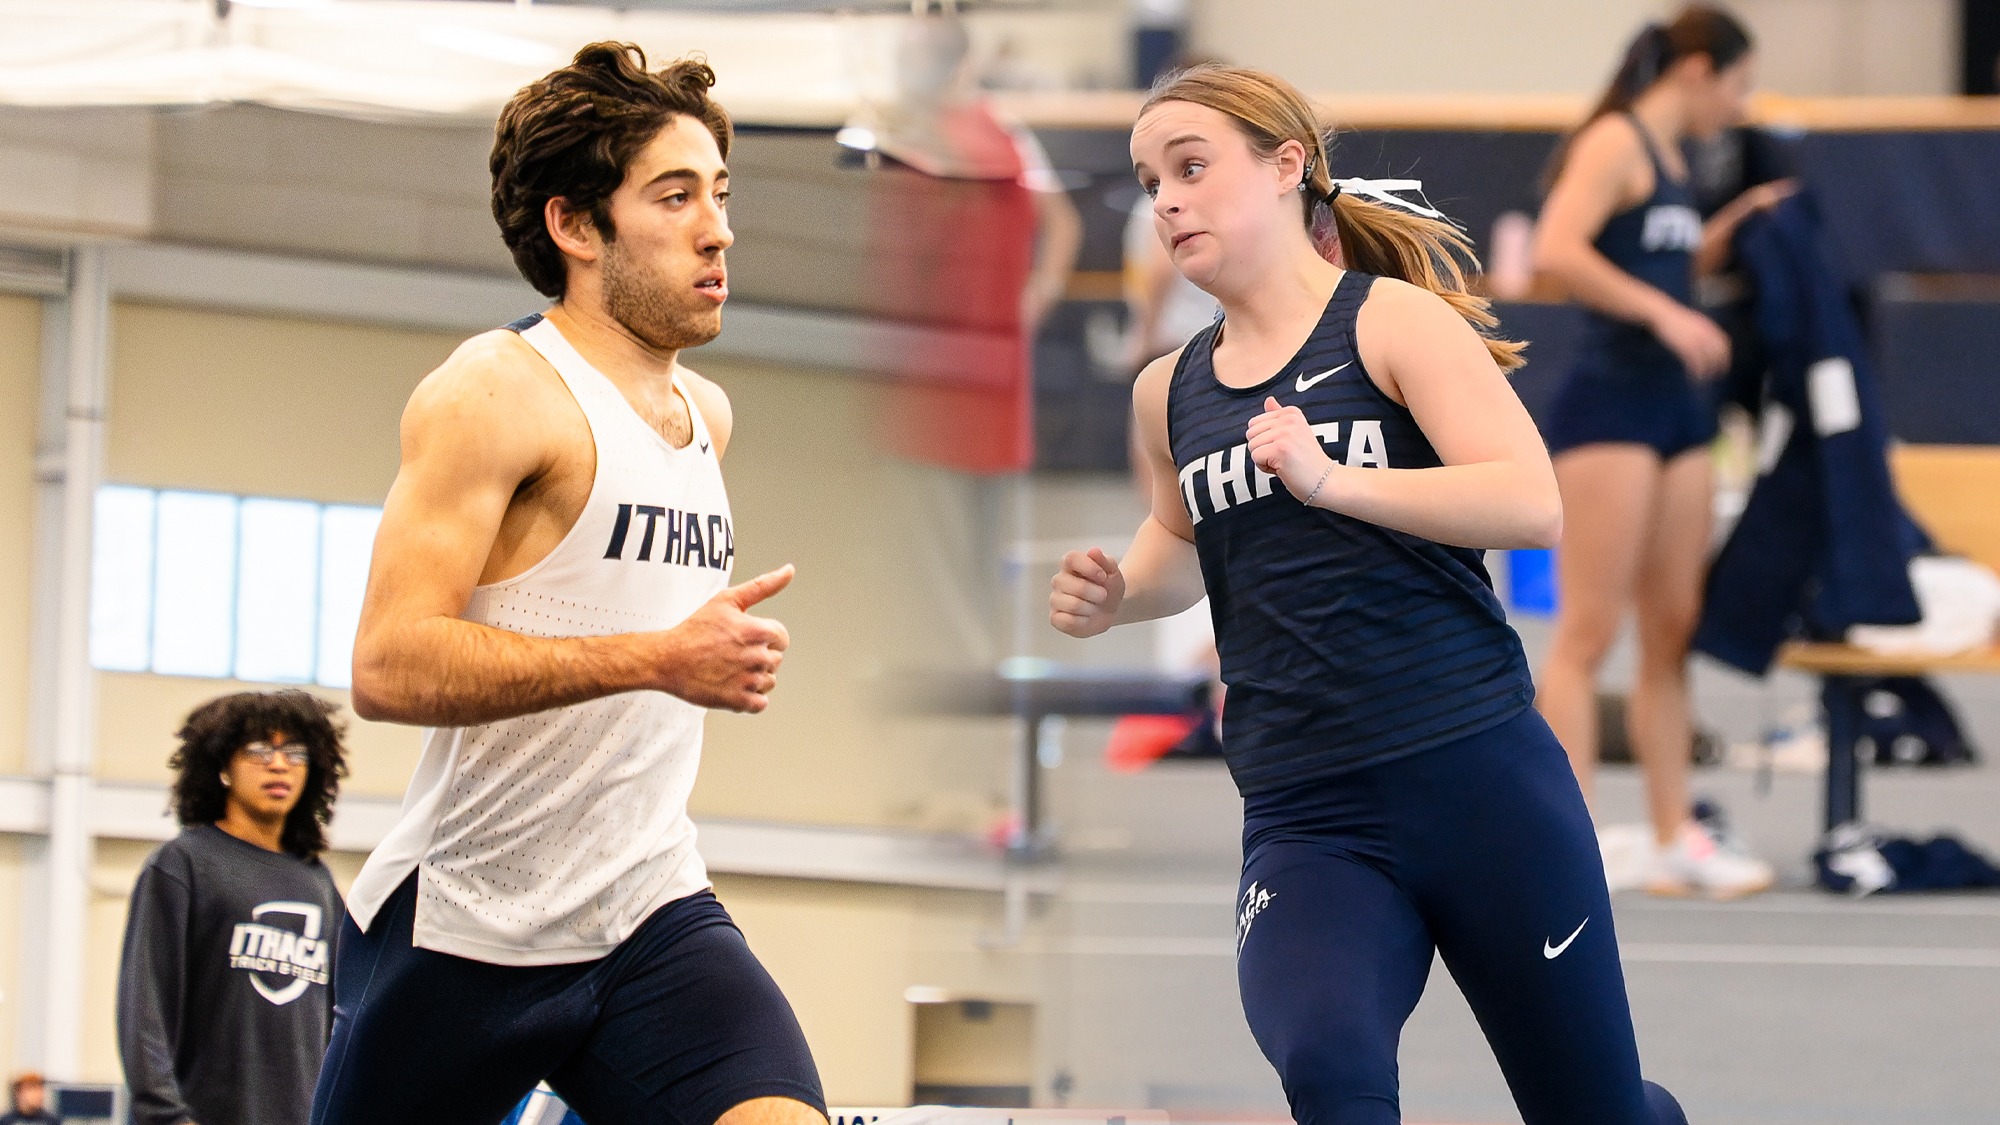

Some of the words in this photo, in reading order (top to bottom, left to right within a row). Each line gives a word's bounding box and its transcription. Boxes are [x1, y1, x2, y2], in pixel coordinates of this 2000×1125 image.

[602, 503, 734, 571] ITHACA
[229, 923, 329, 973] ITHACA
[229, 954, 278, 974] TRACK
